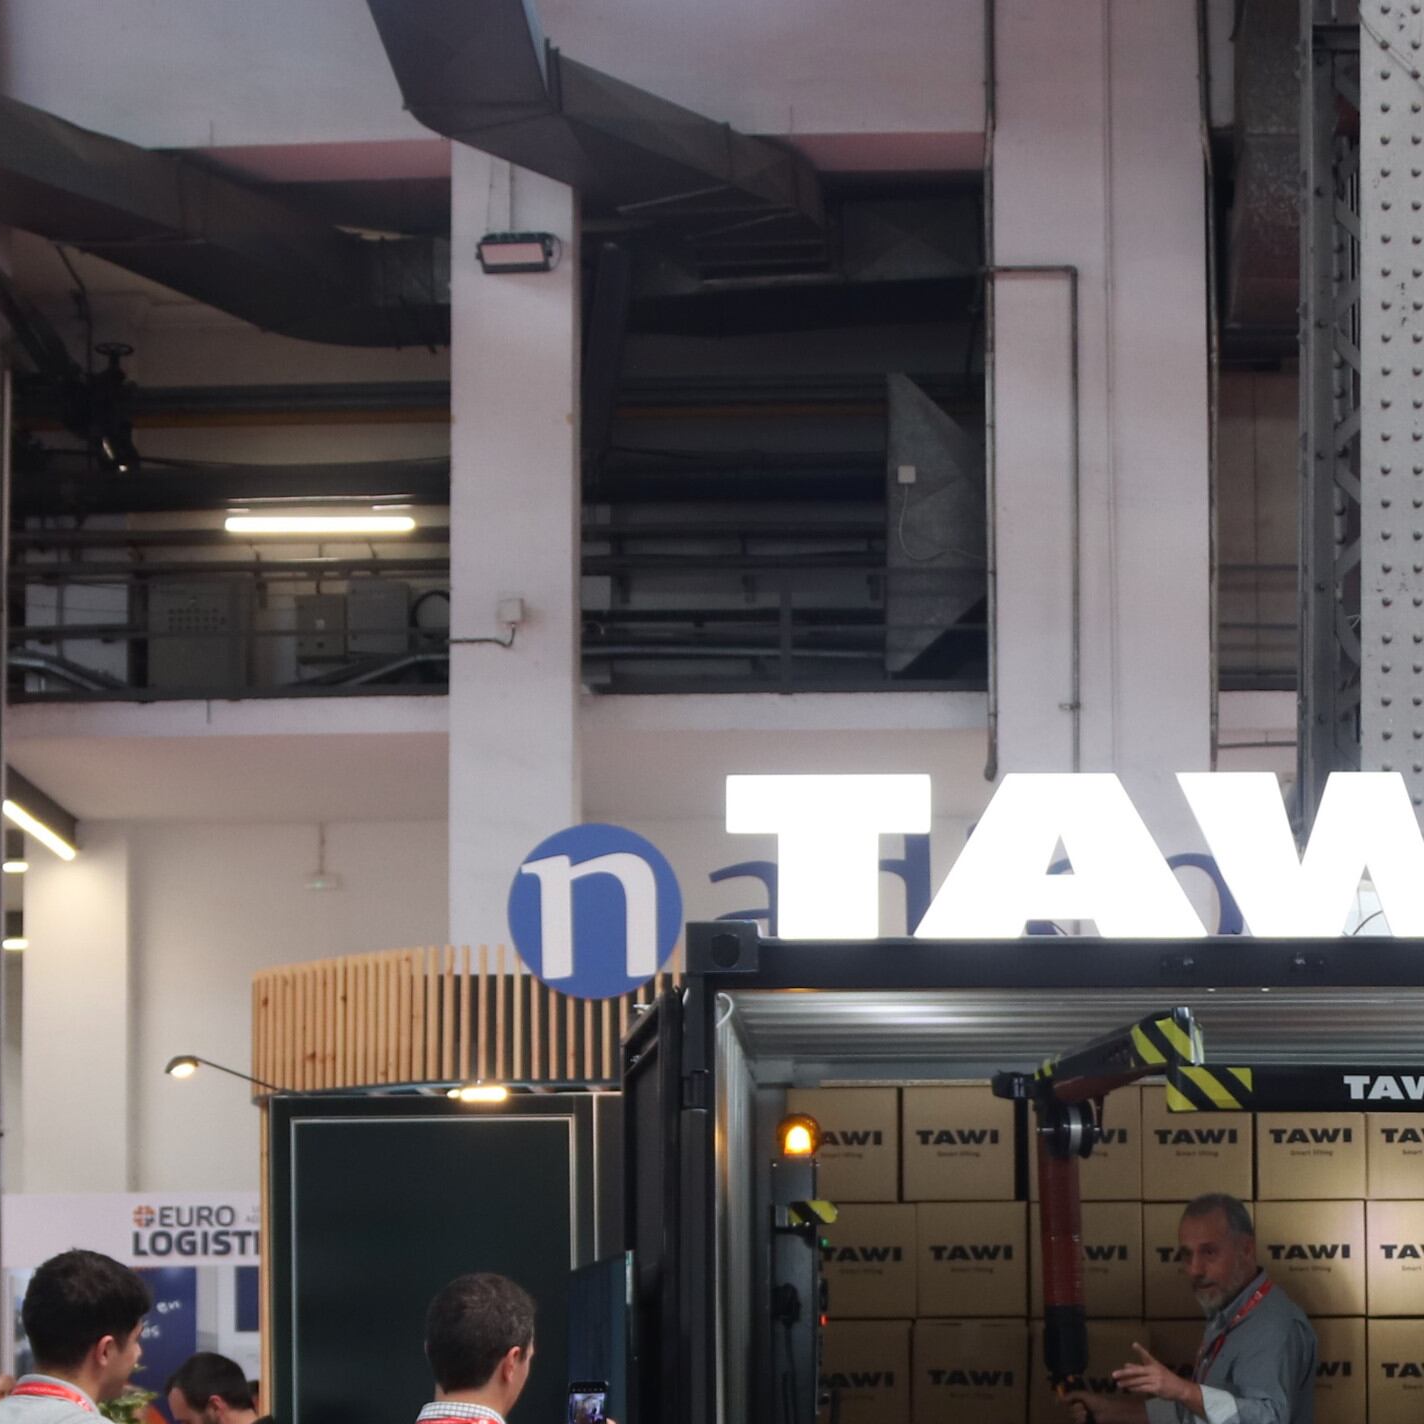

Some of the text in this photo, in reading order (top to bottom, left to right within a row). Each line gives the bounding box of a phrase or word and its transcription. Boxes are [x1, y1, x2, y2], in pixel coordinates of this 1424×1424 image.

[819, 1130, 884, 1147] AWI
[916, 1129, 1000, 1146] TAWI
[1154, 1128, 1238, 1146] TAWI
[1269, 1128, 1352, 1144] TAWI
[159, 1206, 236, 1227] EURO
[132, 1230, 260, 1257] LOGISTI
[1084, 1243, 1129, 1261] WI
[1267, 1244, 1351, 1260] TAWI
[929, 1244, 1014, 1262] TAWI
[928, 1369, 1014, 1388] TAWI
[1317, 1361, 1352, 1378] WI
